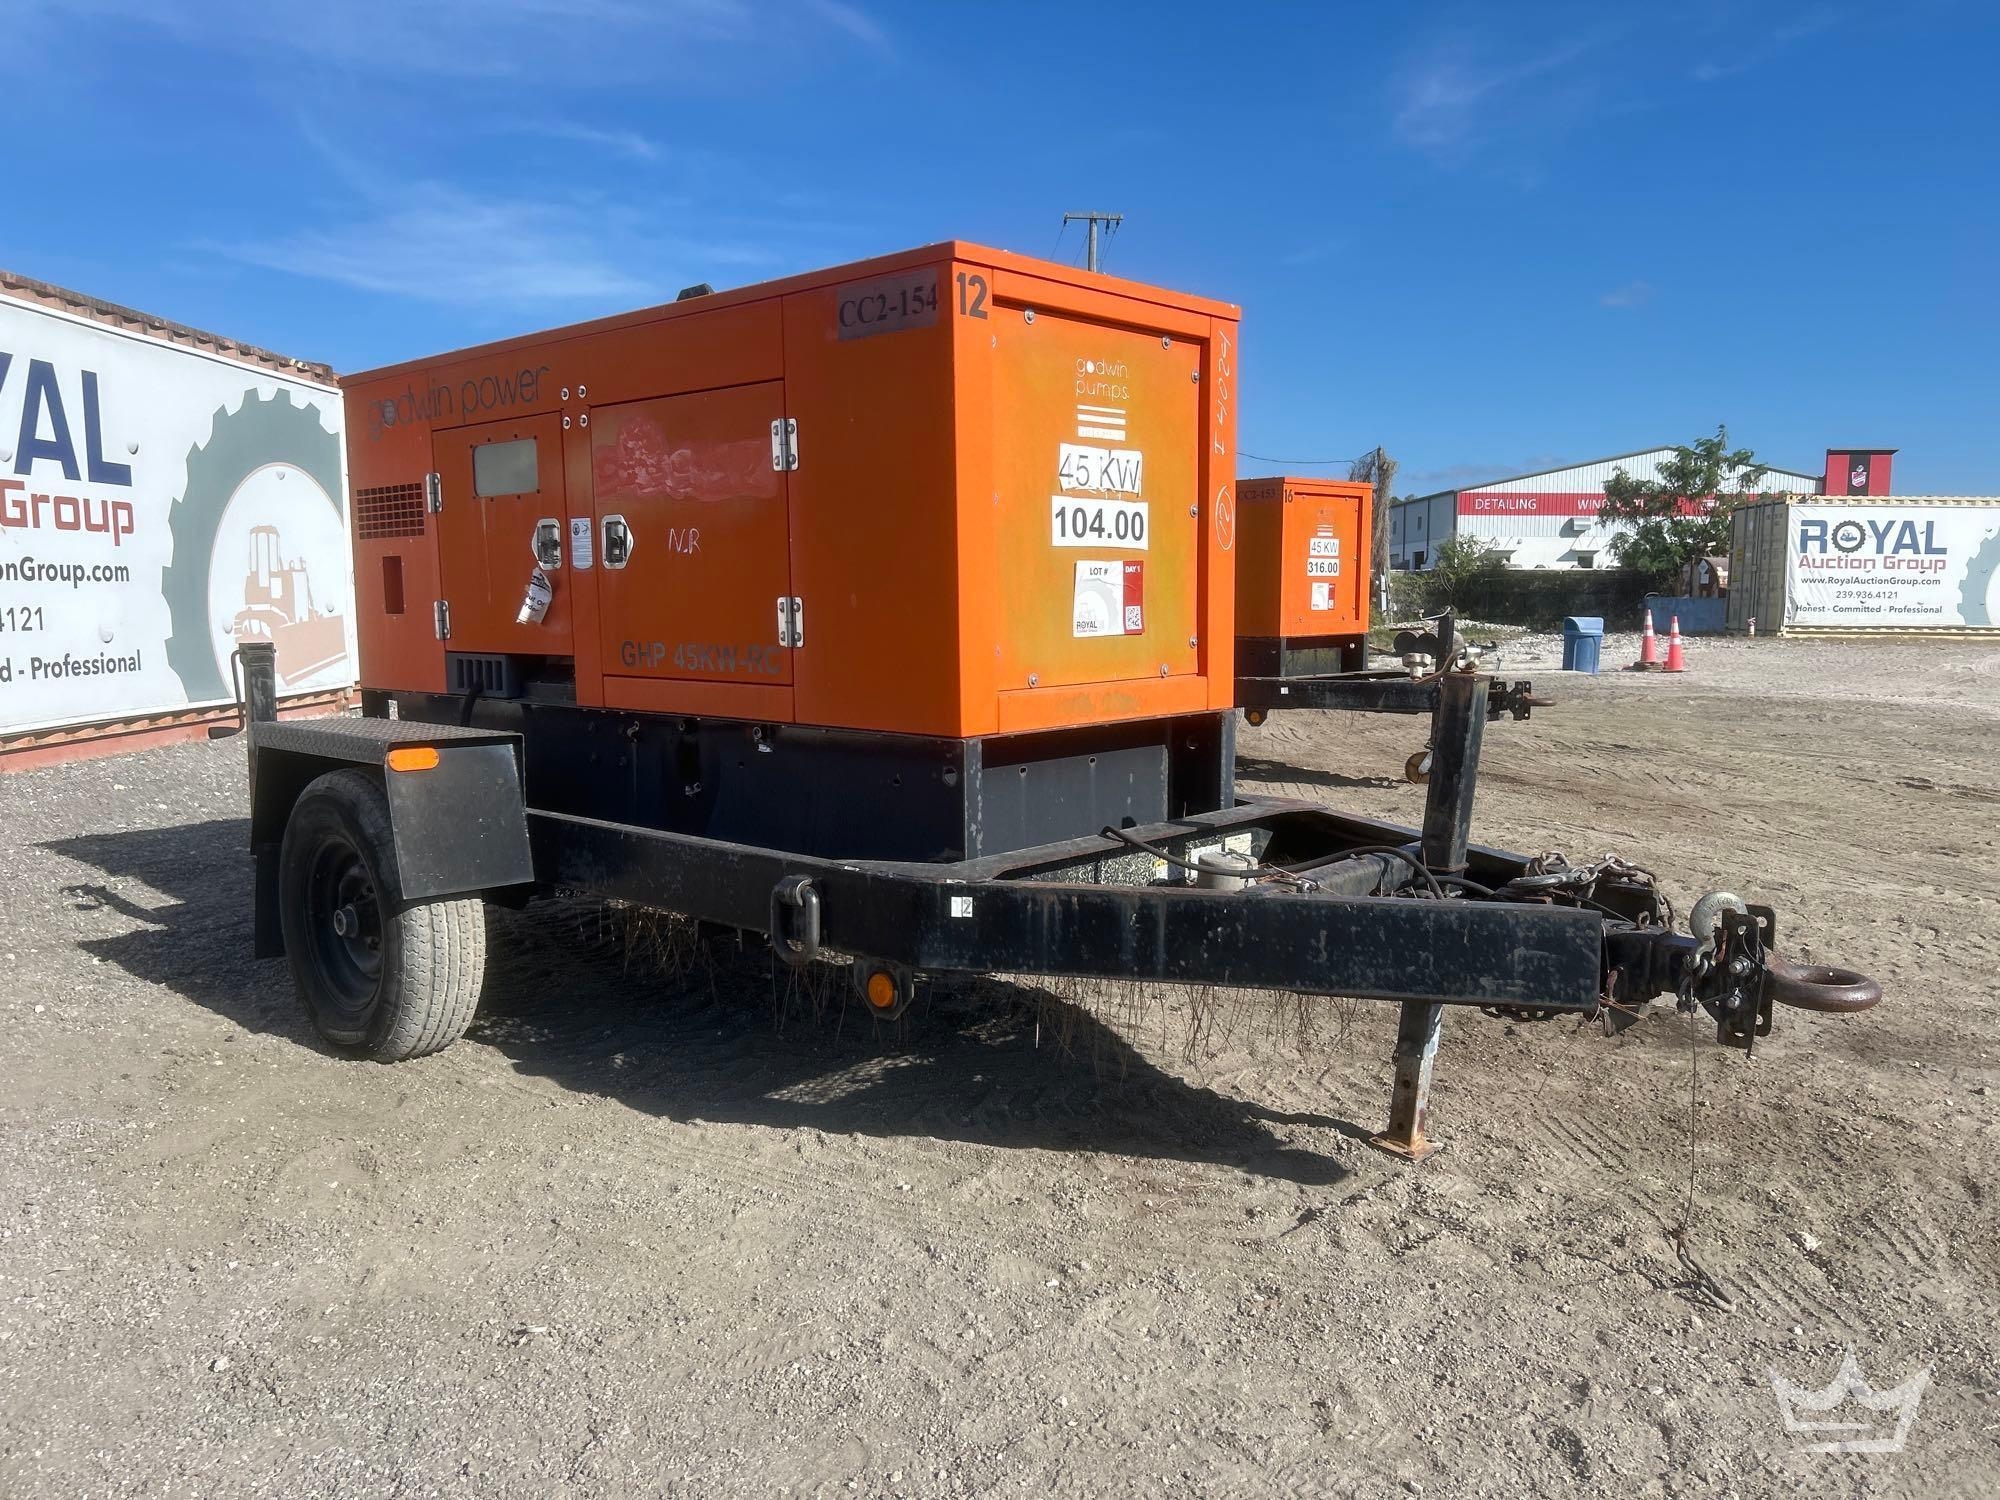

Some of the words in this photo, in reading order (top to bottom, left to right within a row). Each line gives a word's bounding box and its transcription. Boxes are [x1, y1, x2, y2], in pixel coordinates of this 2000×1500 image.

[957, 271, 988, 320] 12
[839, 284, 938, 327] CC2-154
[1076, 358, 1128, 378] godwin
[367, 378, 454, 442] godwin
[462, 366, 550, 425] power
[1058, 452, 1090, 487] 45
[1100, 456, 1140, 490] KW
[1285, 489, 1293, 503] 16
[1475, 498, 1537, 510] DETAILING
[1055, 506, 1144, 541] 104.00
[1800, 520, 1947, 554] ROYAL
[1311, 541, 1322, 553] 45
[1324, 541, 1337, 553] KW
[0, 556, 129, 588] nGroup.com
[1089, 567, 1102, 576] LOT
[1308, 561, 1338, 573] 316.00
[1798, 555, 1876, 570] Auction
[1883, 555, 1947, 573] Group
[1801, 577, 1941, 587] www.RoyalAuctionGroup.com
[1836, 591, 1898, 599] 239.936.4121
[1796, 605, 1826, 613] Honest
[1832, 605, 1881, 613] Committed
[1889, 605, 1943, 614] Professional
[1077, 621, 1097, 629] ROYAL
[31, 649, 141, 680] Professional
[621, 640, 665, 669] GHP
[673, 643, 783, 676] 45KW-RC
